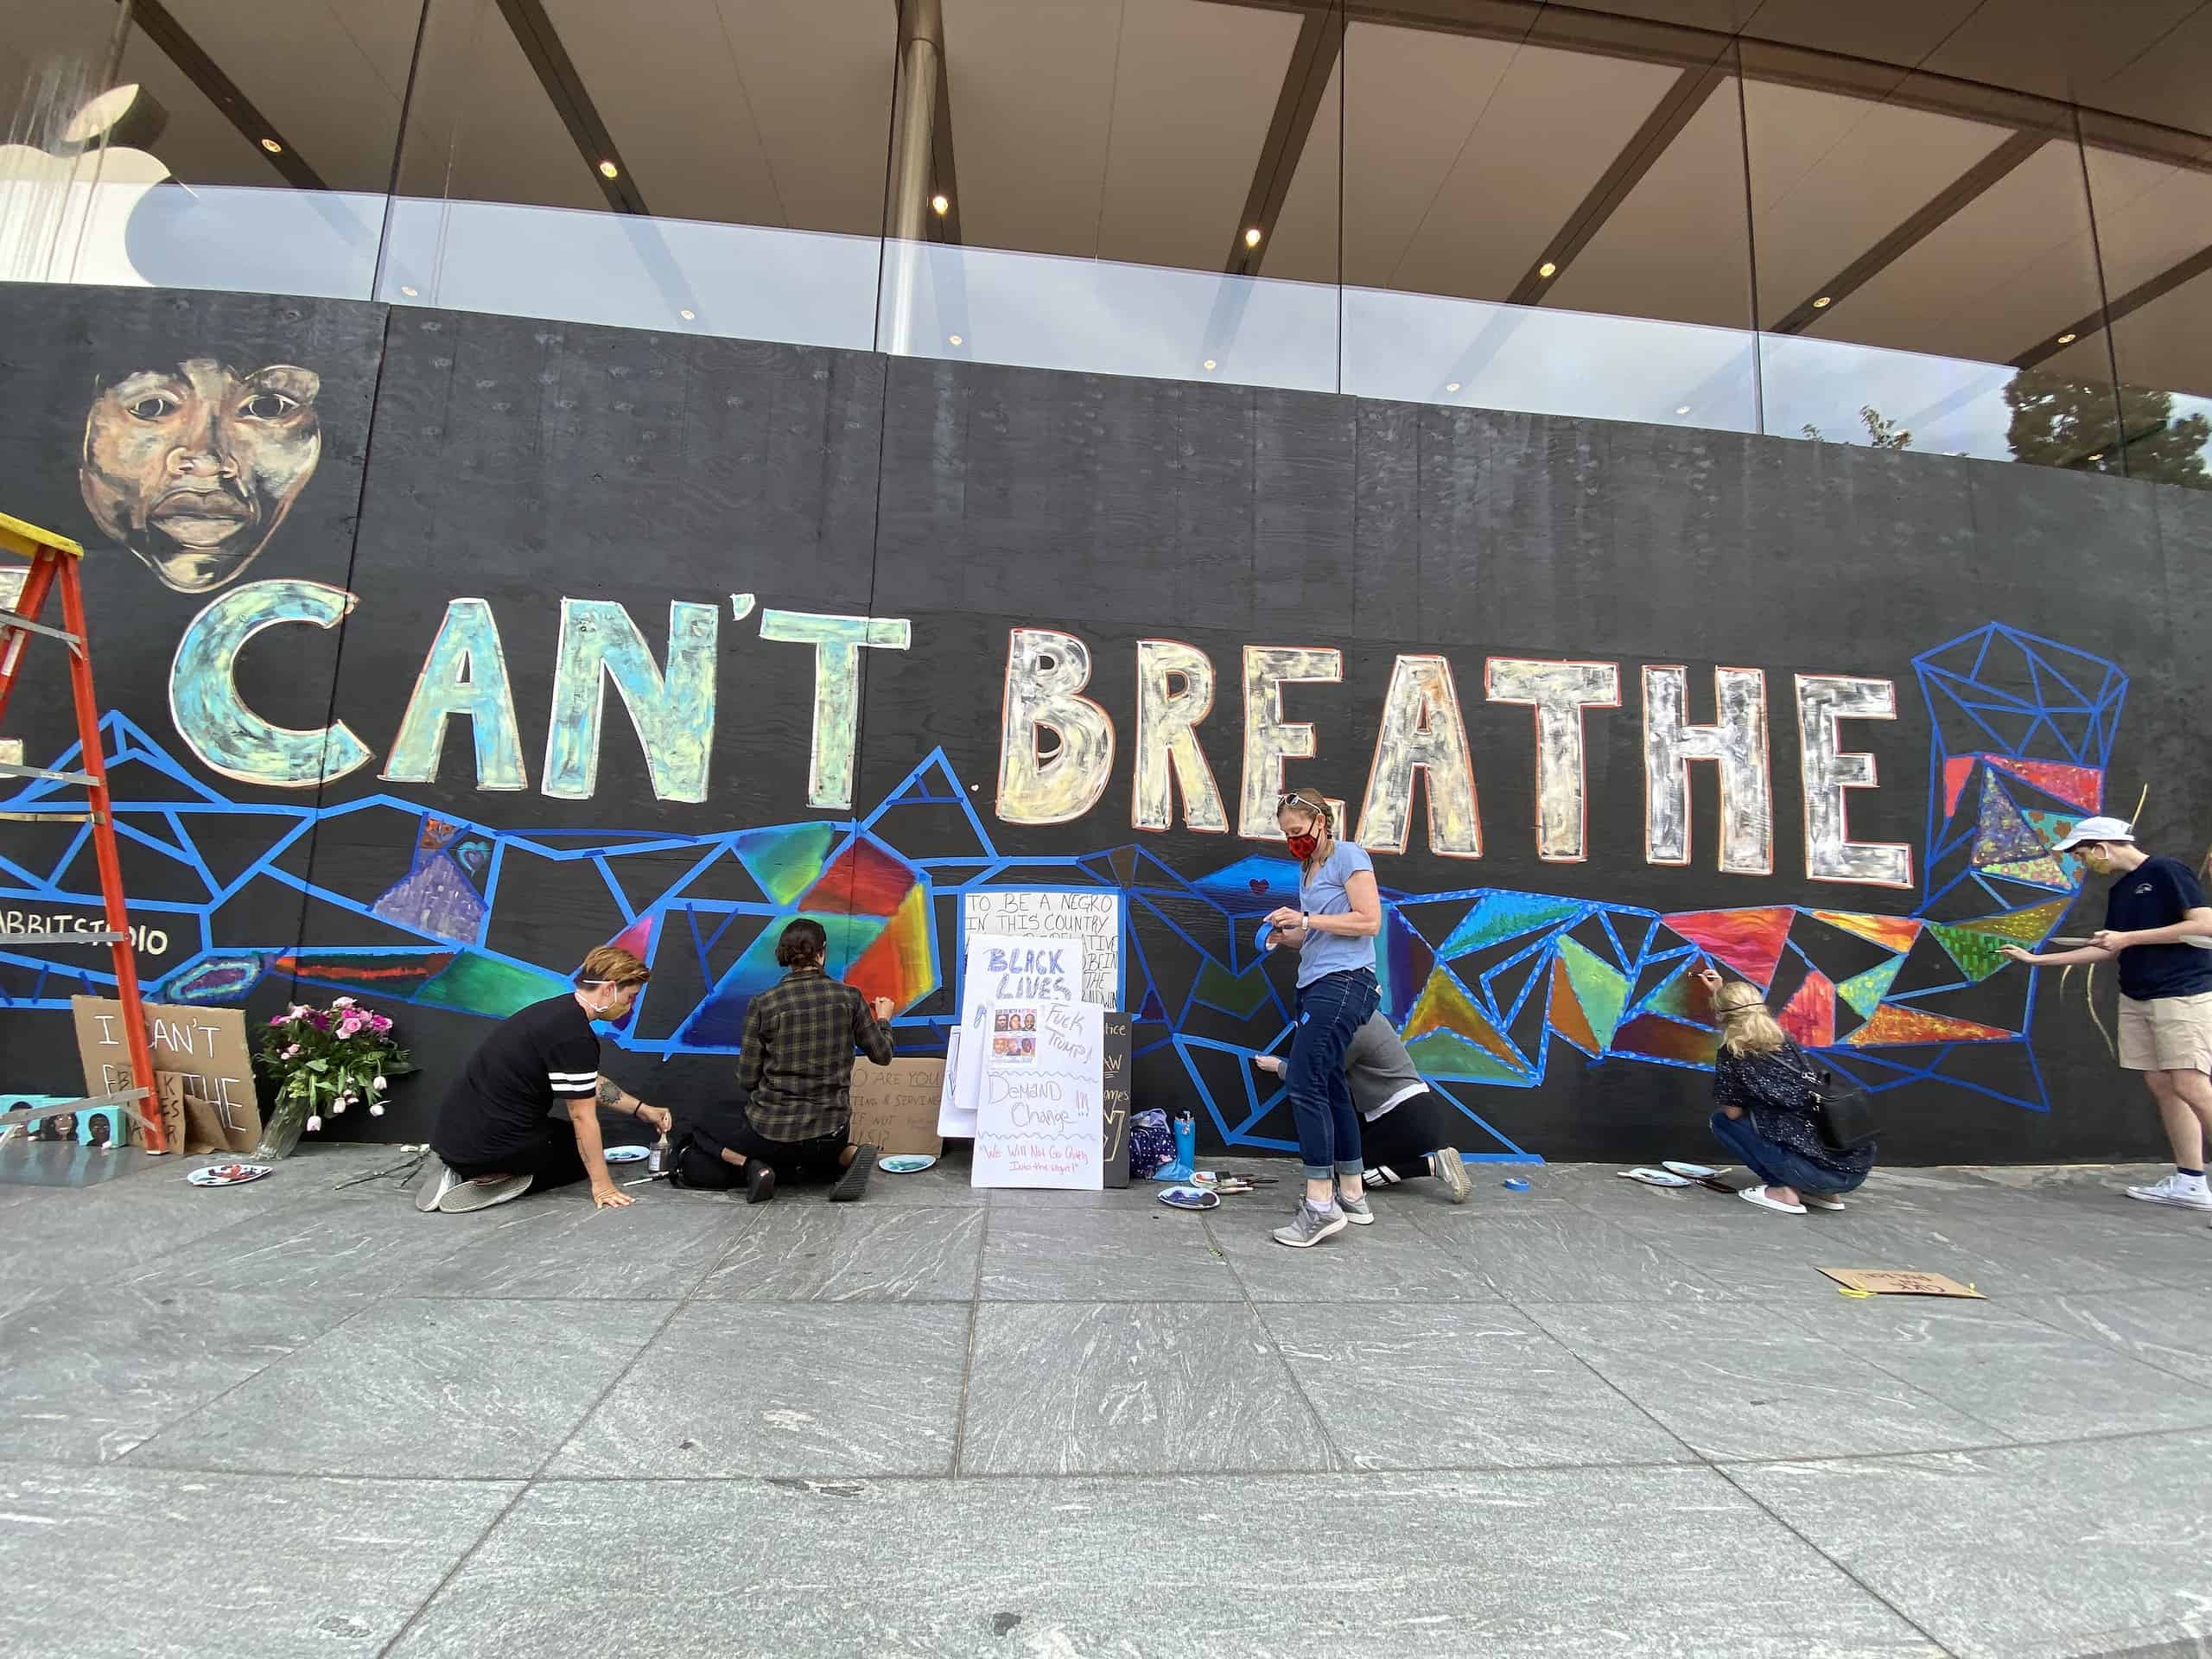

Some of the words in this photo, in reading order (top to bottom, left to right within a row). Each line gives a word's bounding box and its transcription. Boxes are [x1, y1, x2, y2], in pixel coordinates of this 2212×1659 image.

[168, 579, 912, 810] CAN'T
[995, 627, 1915, 890] BREATHE
[967, 894, 991, 912] TO
[996, 893, 1033, 914] BE
[1039, 893, 1052, 911] A
[965, 912, 989, 931] IN
[995, 913, 1040, 932] THIS
[1044, 913, 1109, 934] COUNTRY
[982, 948, 1065, 976] BLACK
[995, 974, 1071, 1002] LIVES
[1084, 969, 1111, 989] THE
[94, 1015, 120, 1046] I
[907, 1071, 941, 1088] YOU
